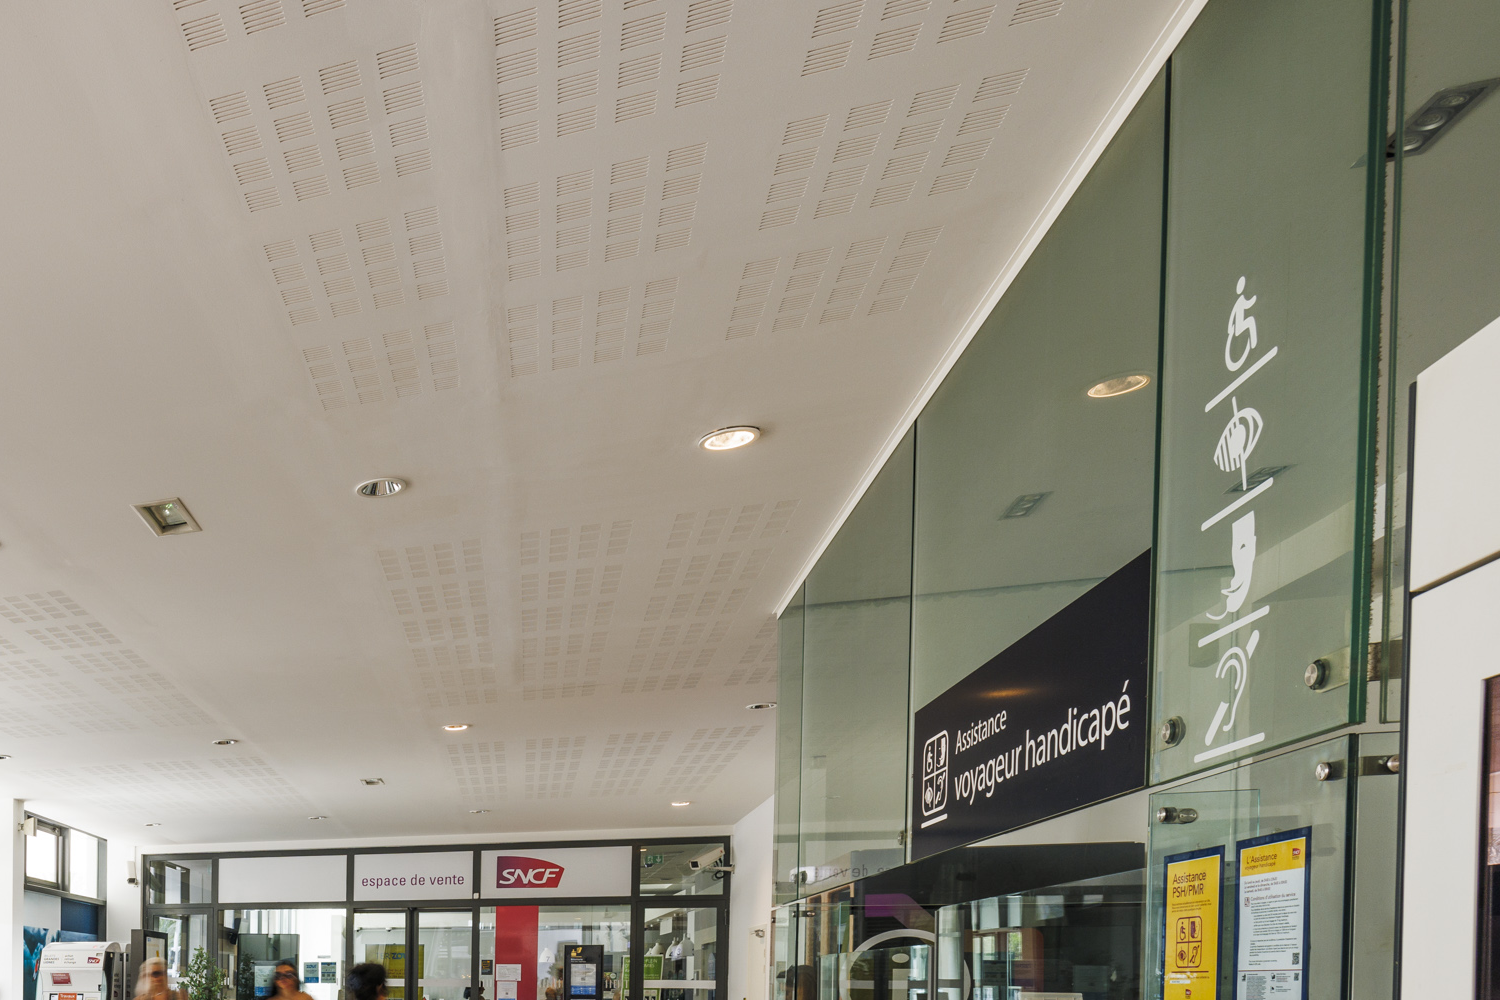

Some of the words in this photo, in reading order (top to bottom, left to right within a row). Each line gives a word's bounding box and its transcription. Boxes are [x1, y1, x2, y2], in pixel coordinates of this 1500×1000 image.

[955, 710, 1007, 754] Assistance
[954, 745, 1022, 805] voyageur
[1025, 680, 1130, 770] handicapé
[1247, 854, 1277, 864] L'Assistance
[361, 875, 406, 889] espace
[410, 874, 425, 886] de
[429, 874, 465, 886] vente
[499, 868, 559, 884] SNCF
[1173, 871, 1206, 886] Assistance
[1172, 883, 1204, 899] PSH/PMR
